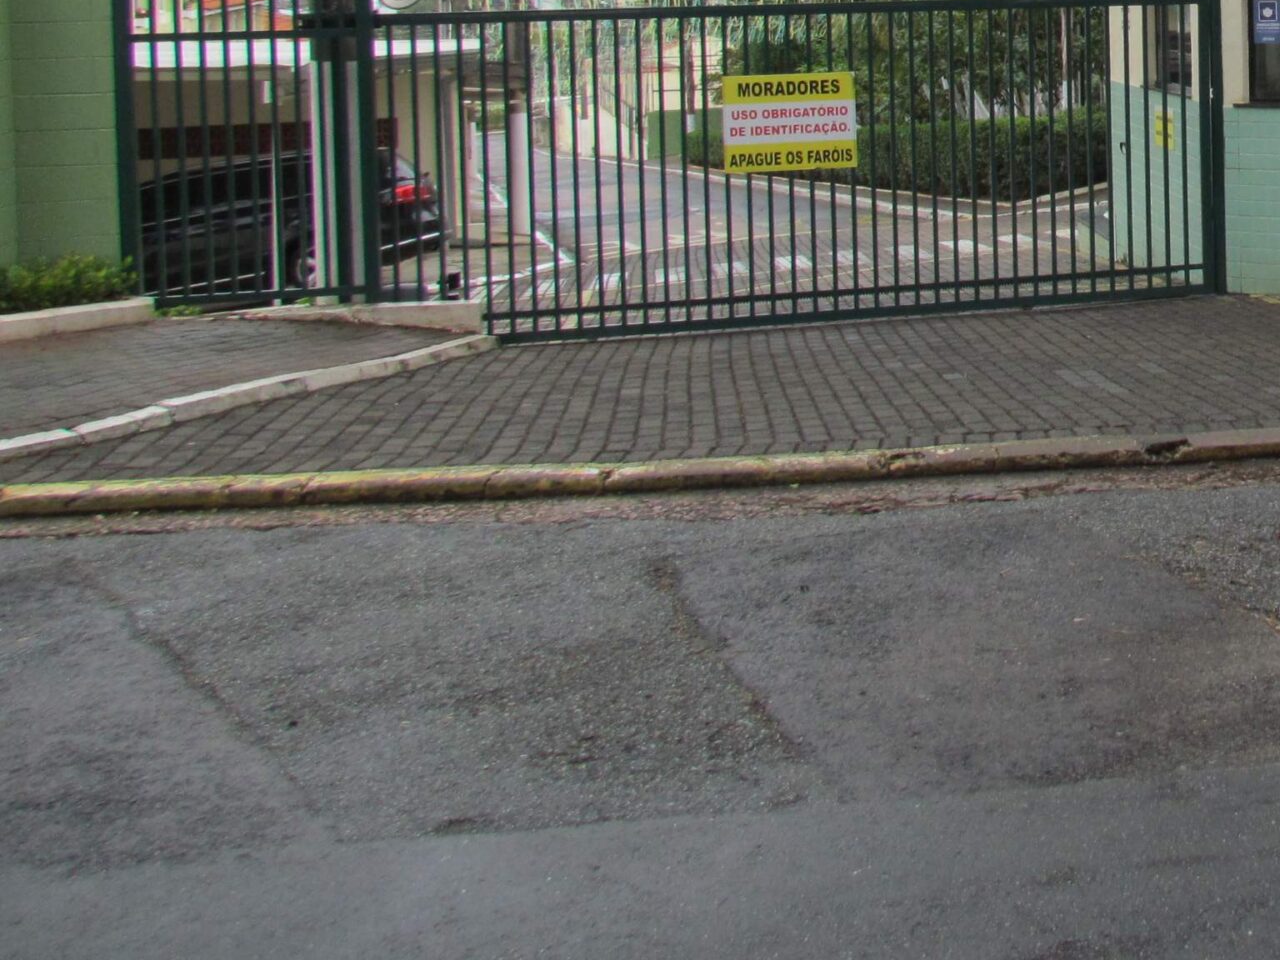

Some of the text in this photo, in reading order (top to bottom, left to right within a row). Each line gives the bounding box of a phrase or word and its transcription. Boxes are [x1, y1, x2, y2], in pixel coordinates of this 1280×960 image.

[737, 79, 840, 98] MORADORES
[731, 105, 848, 120] USO OBRIGATÓRIO
[730, 121, 851, 137] DE IDENTIFICAÇÃO.
[730, 146, 853, 168] APAGUE OS FARÓIS
